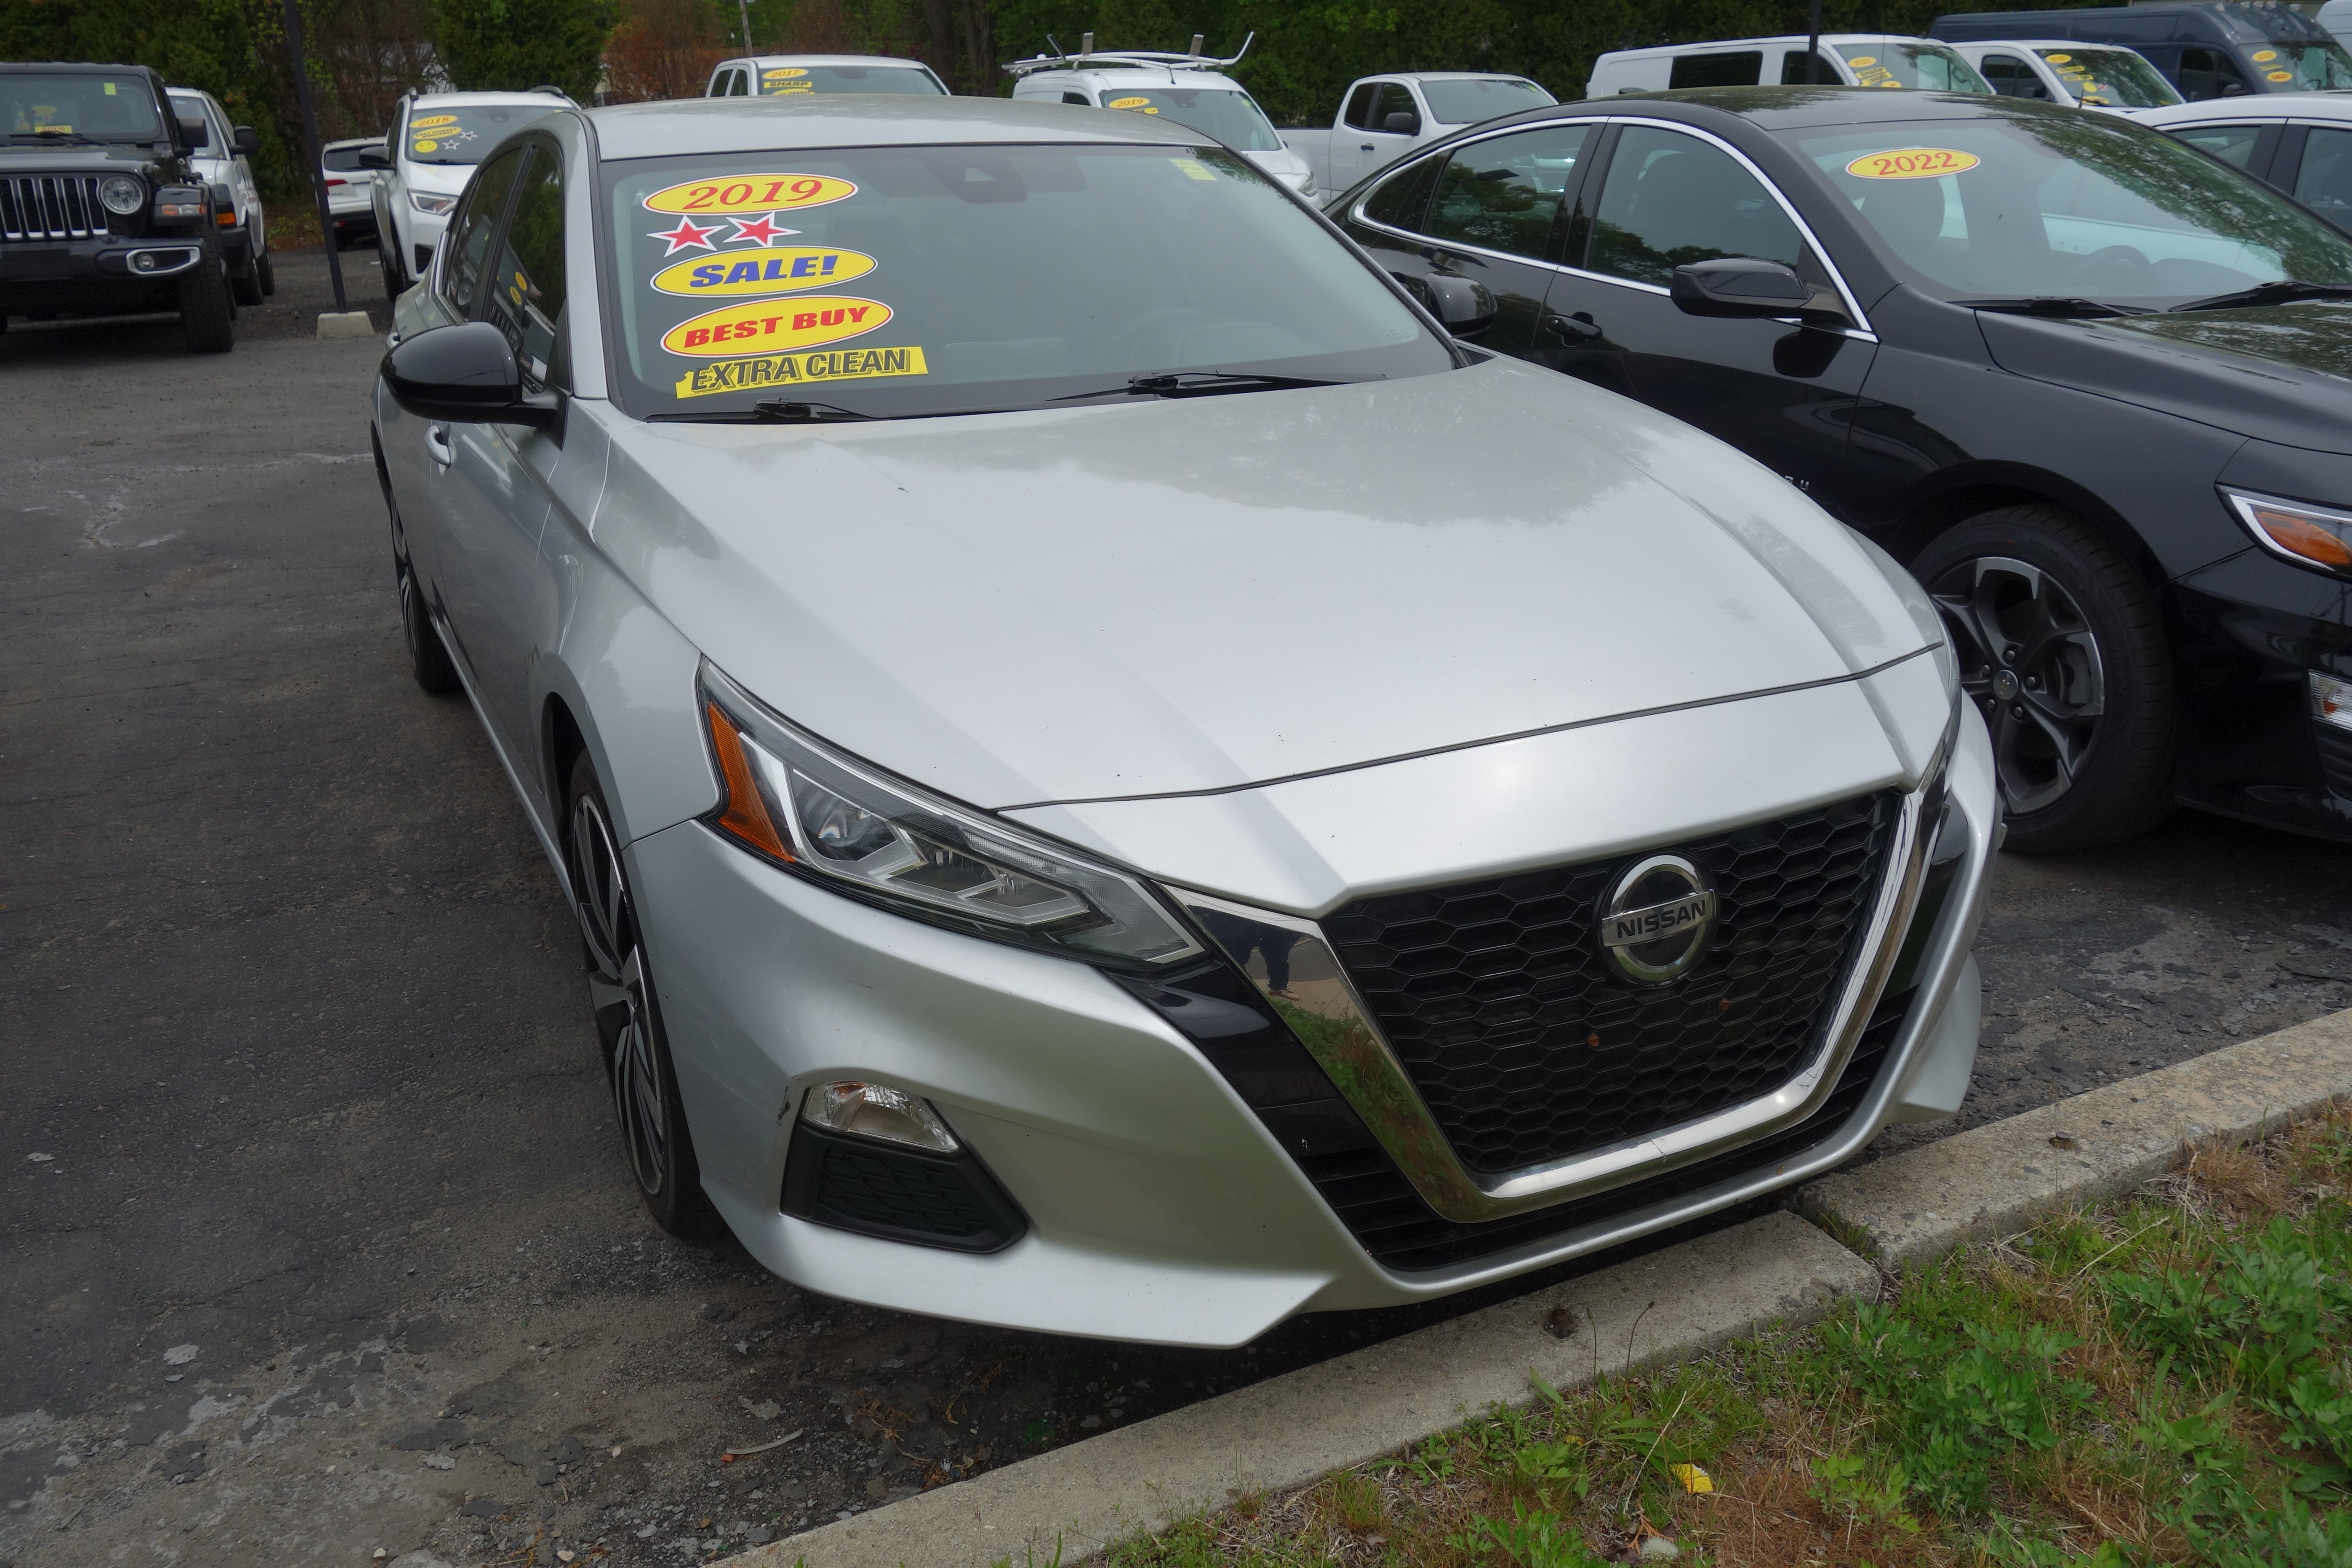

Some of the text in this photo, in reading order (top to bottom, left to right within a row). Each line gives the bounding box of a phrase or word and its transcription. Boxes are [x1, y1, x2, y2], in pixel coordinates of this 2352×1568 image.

[771, 70, 799, 78] 2017
[1117, 98, 1143, 107] 2019
[419, 116, 449, 127] 2018
[1873, 152, 1958, 175] 2022
[682, 180, 822, 210] 2019
[689, 255, 839, 288] SALE!
[684, 306, 870, 349] BEST BUY
[691, 349, 910, 393] EXTRA CLEAN
[1617, 899, 1706, 939] NISSAN
